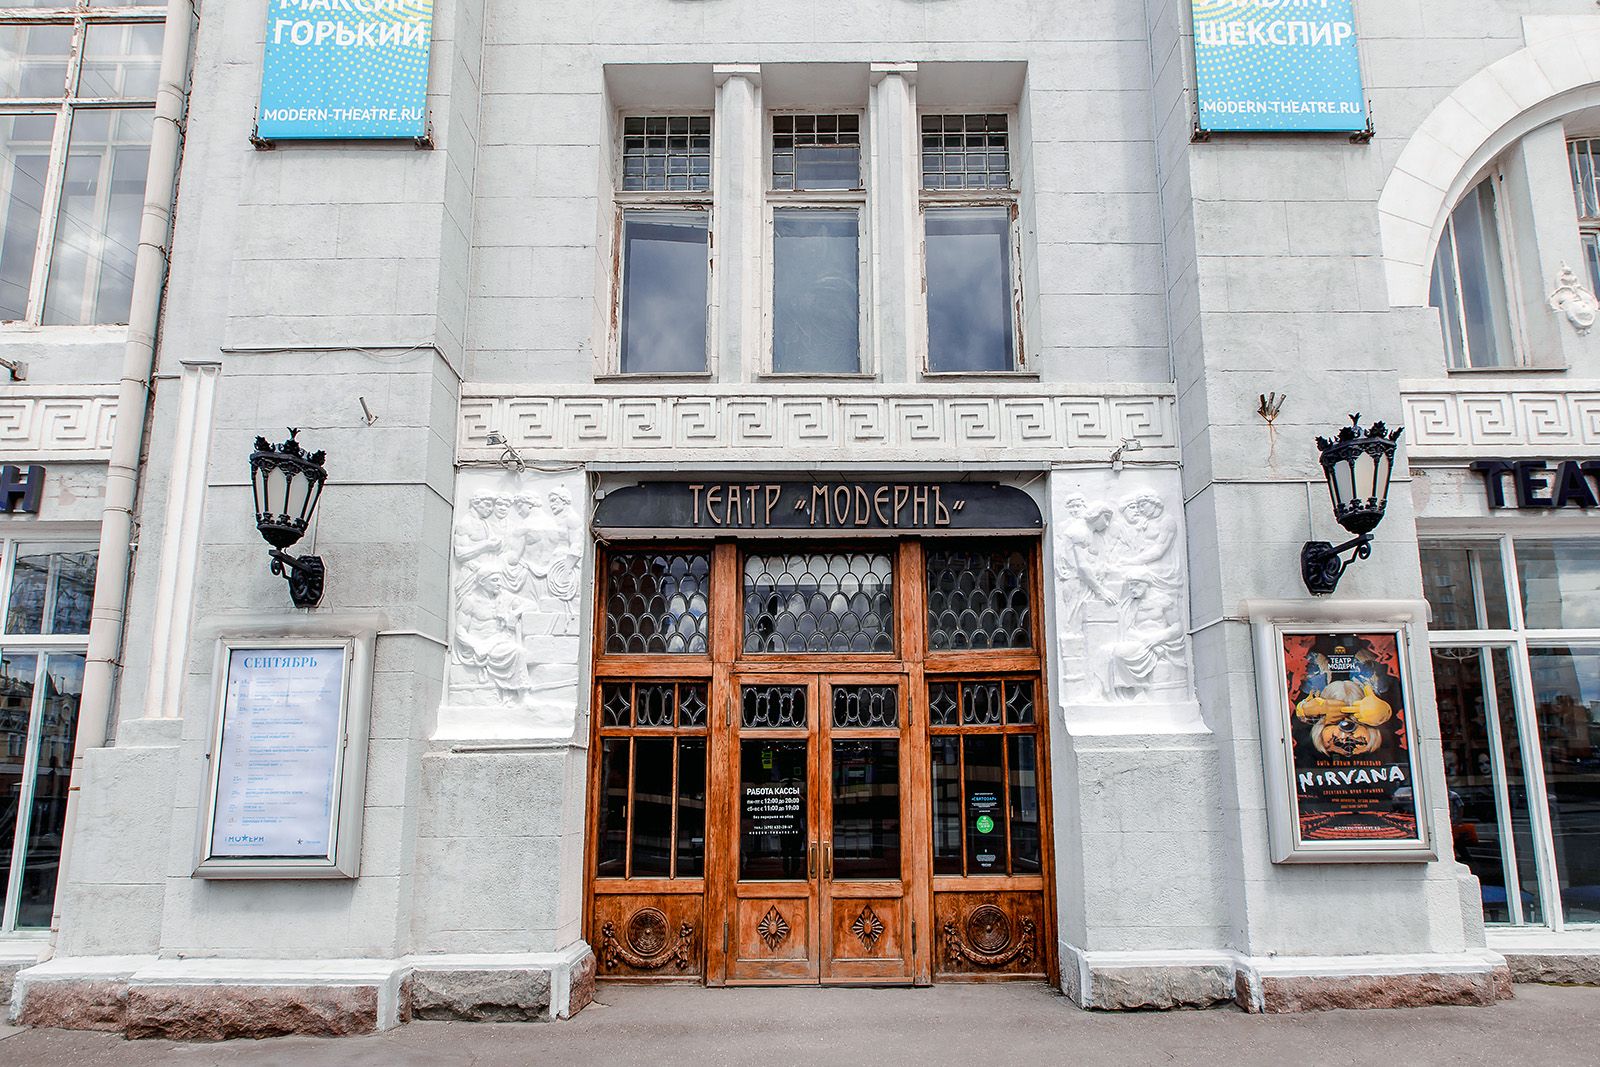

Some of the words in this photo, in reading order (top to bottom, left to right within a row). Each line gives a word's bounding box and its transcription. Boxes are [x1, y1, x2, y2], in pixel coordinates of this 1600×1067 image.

[274, 17, 425, 46] ГОРЬКИЙ
[1200, 20, 1352, 46] ШЕКСПИР
[264, 107, 422, 121] MODERN-THEATRE.RU
[1203, 100, 1360, 114] MODERN-THEATRE.RU
[689, 485, 781, 525] ТЕАТР
[243, 656, 317, 669] СЕНТЯБРЬ
[1327, 663, 1356, 671] МОДЕРН
